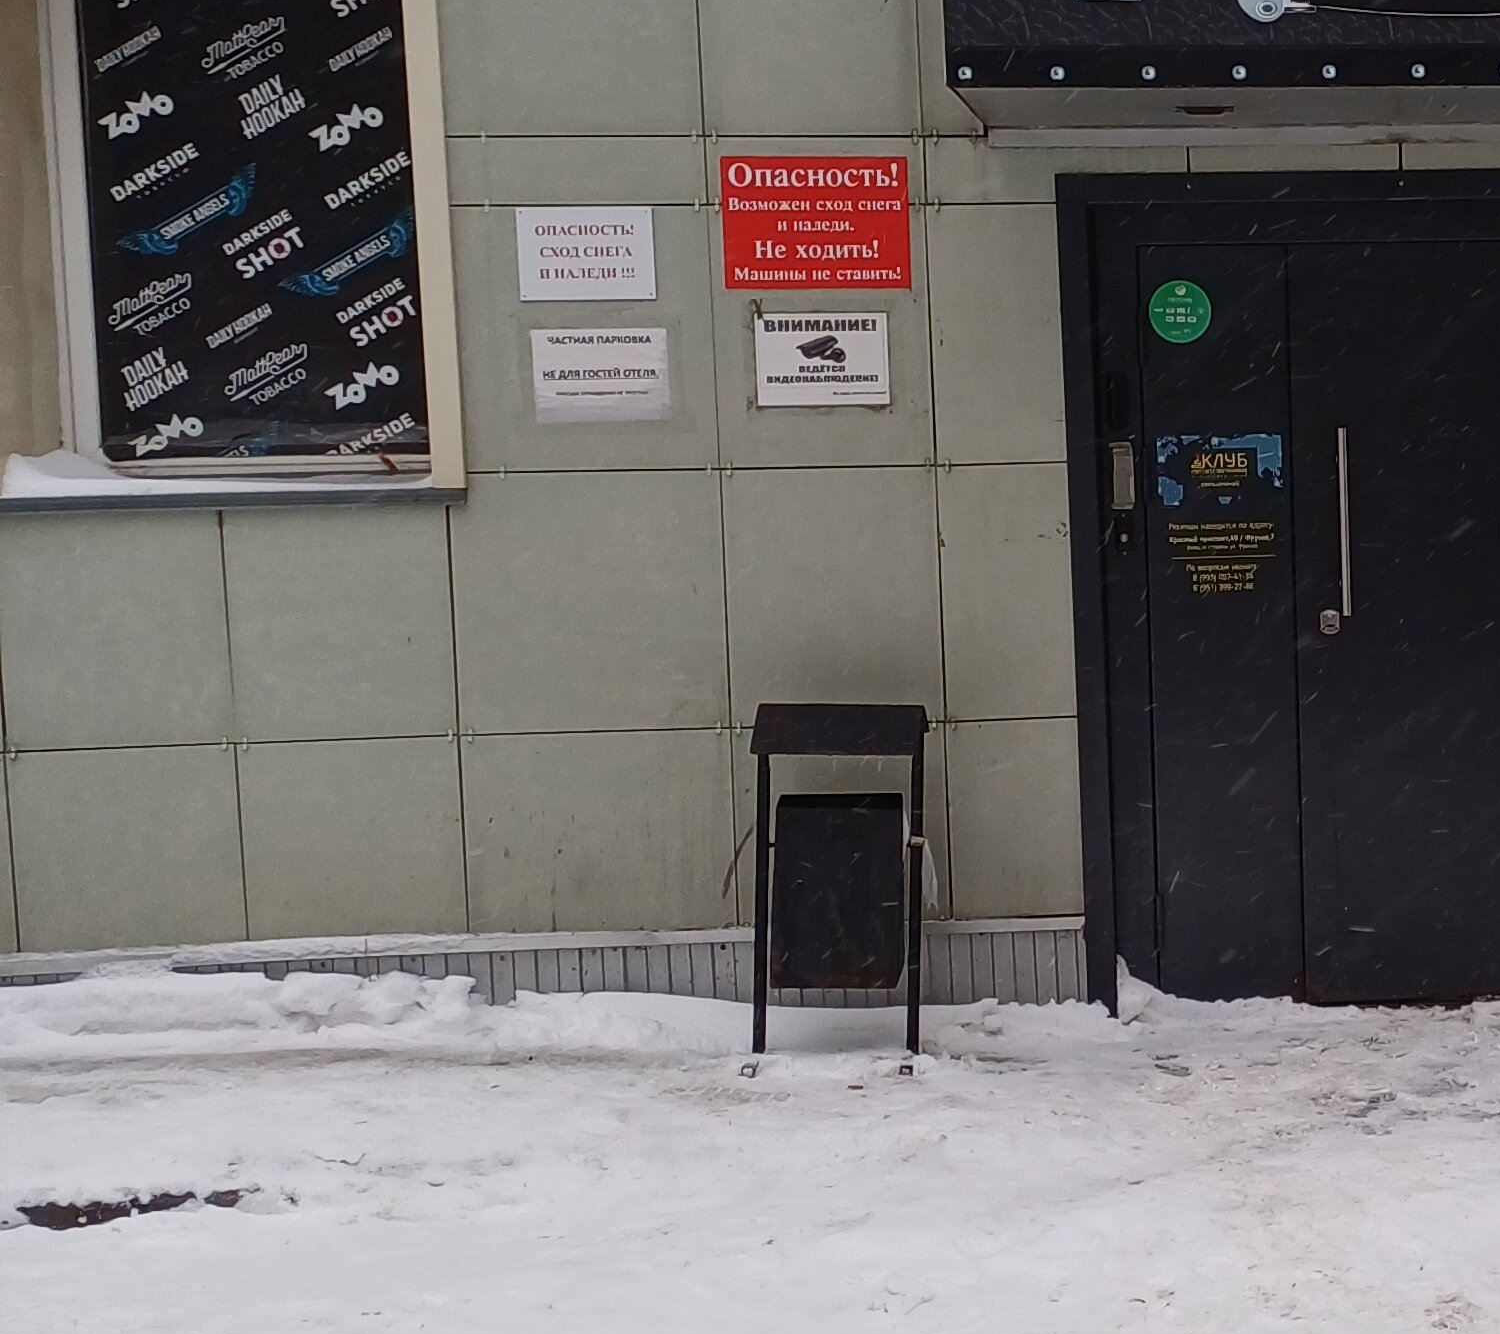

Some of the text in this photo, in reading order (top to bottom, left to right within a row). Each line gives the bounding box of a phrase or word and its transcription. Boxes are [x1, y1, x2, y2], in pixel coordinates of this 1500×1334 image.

[227, 42, 284, 79] TOBACCO
[238, 74, 284, 115] DAILY
[240, 89, 306, 139] HOOKAH
[110, 143, 200, 201] DARKSIDE
[324, 151, 411, 209] DARKSIDE
[728, 162, 898, 187] Опасность!
[728, 197, 901, 213] Возможен сход снега
[222, 208, 293, 256] DARKSIDE
[534, 225, 634, 235] ОПАСНОСТЬ!
[777, 220, 855, 232] и наледи.
[235, 226, 305, 279] SHOT
[539, 246, 632, 258] СХОД СНЕГА
[753, 239, 879, 260] Не ходить!
[734, 267, 901, 281] Машины не ставить!
[134, 297, 191, 336] TOBACCO
[336, 277, 406, 325] DARKSIDE
[349, 295, 417, 347] SHOT
[764, 318, 877, 332] ВНИМАНИЕ!
[121, 346, 167, 387] DAILY
[124, 360, 189, 411] HOOKAH
[249, 368, 307, 406] TOBACCO
[326, 412, 415, 455] ARKSIDE
[1202, 453, 1248, 468] КЛУБ
